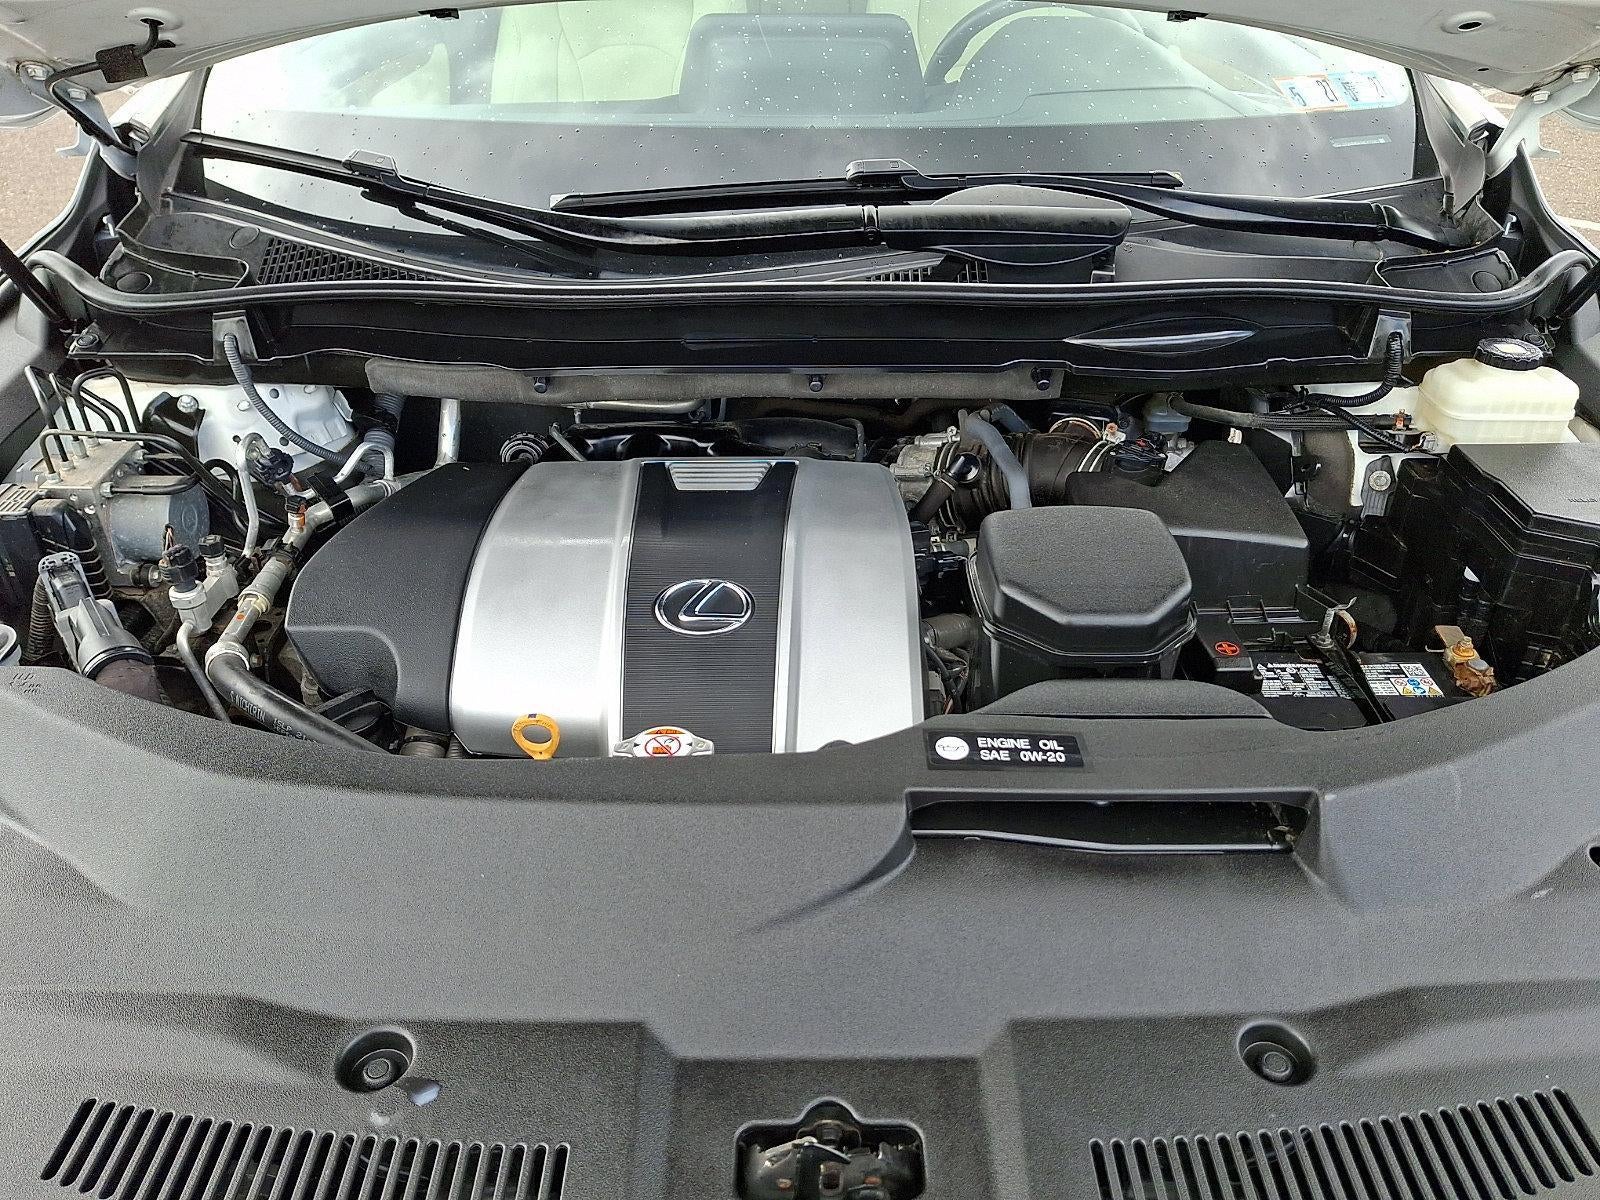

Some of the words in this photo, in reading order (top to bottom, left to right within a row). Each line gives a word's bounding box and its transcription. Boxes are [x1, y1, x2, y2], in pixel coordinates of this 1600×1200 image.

[977, 737, 1031, 749] ENGINE
[1038, 739, 1065, 751] OIL
[979, 750, 1011, 761] SAE
[1019, 750, 1066, 762] 0W-20
